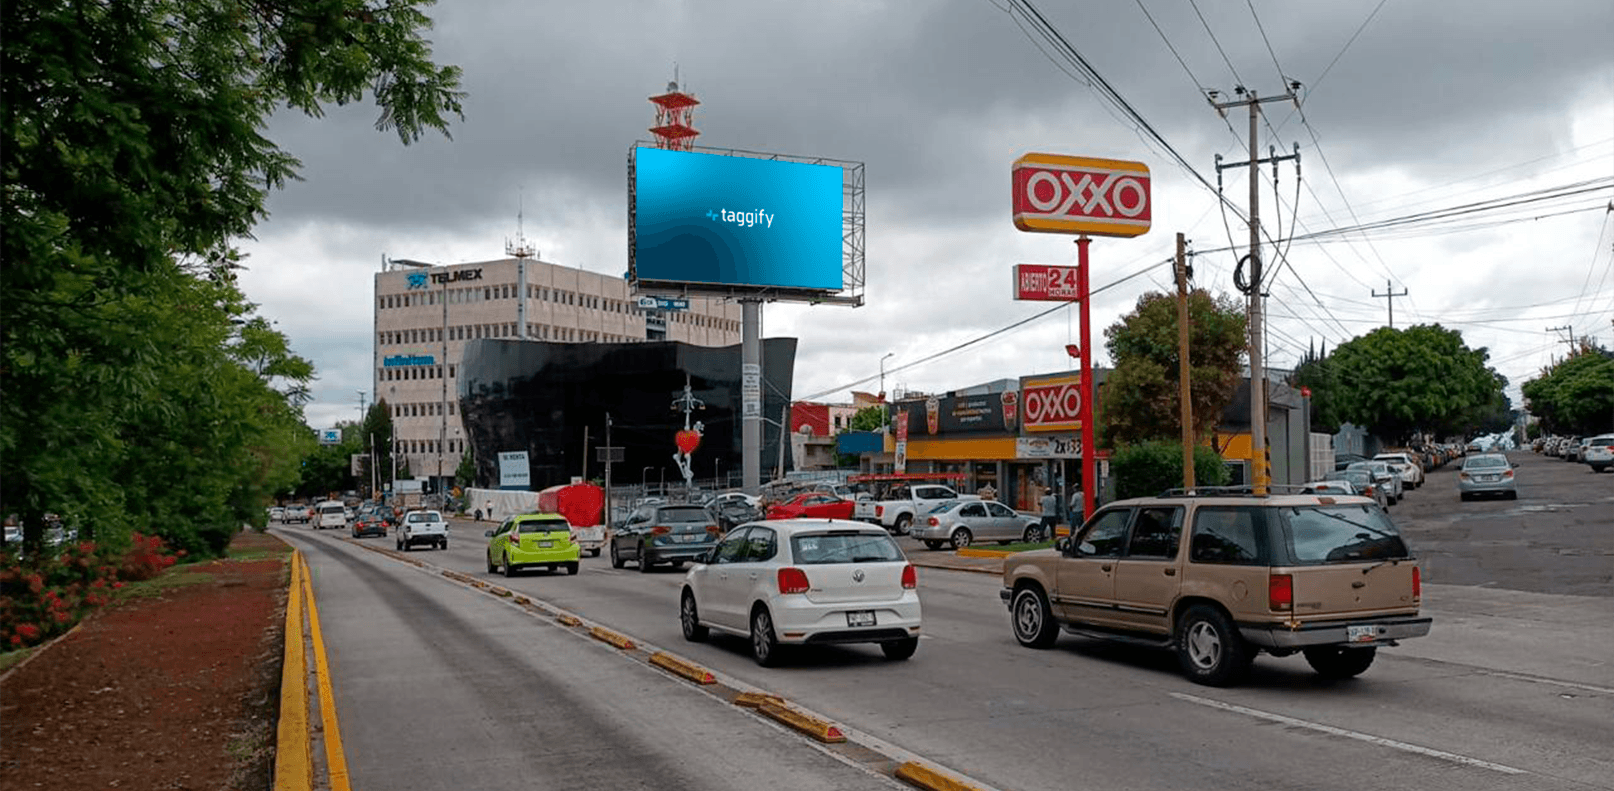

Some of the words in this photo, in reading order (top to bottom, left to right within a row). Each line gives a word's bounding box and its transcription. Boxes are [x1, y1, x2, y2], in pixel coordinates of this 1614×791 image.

[1027, 171, 1146, 217] OXXO
[721, 208, 774, 228] taggify
[430, 268, 482, 284] TELMEX
[1021, 272, 1047, 293] ABIERTO
[1048, 269, 1076, 288] 24
[1026, 386, 1081, 422] OXXO
